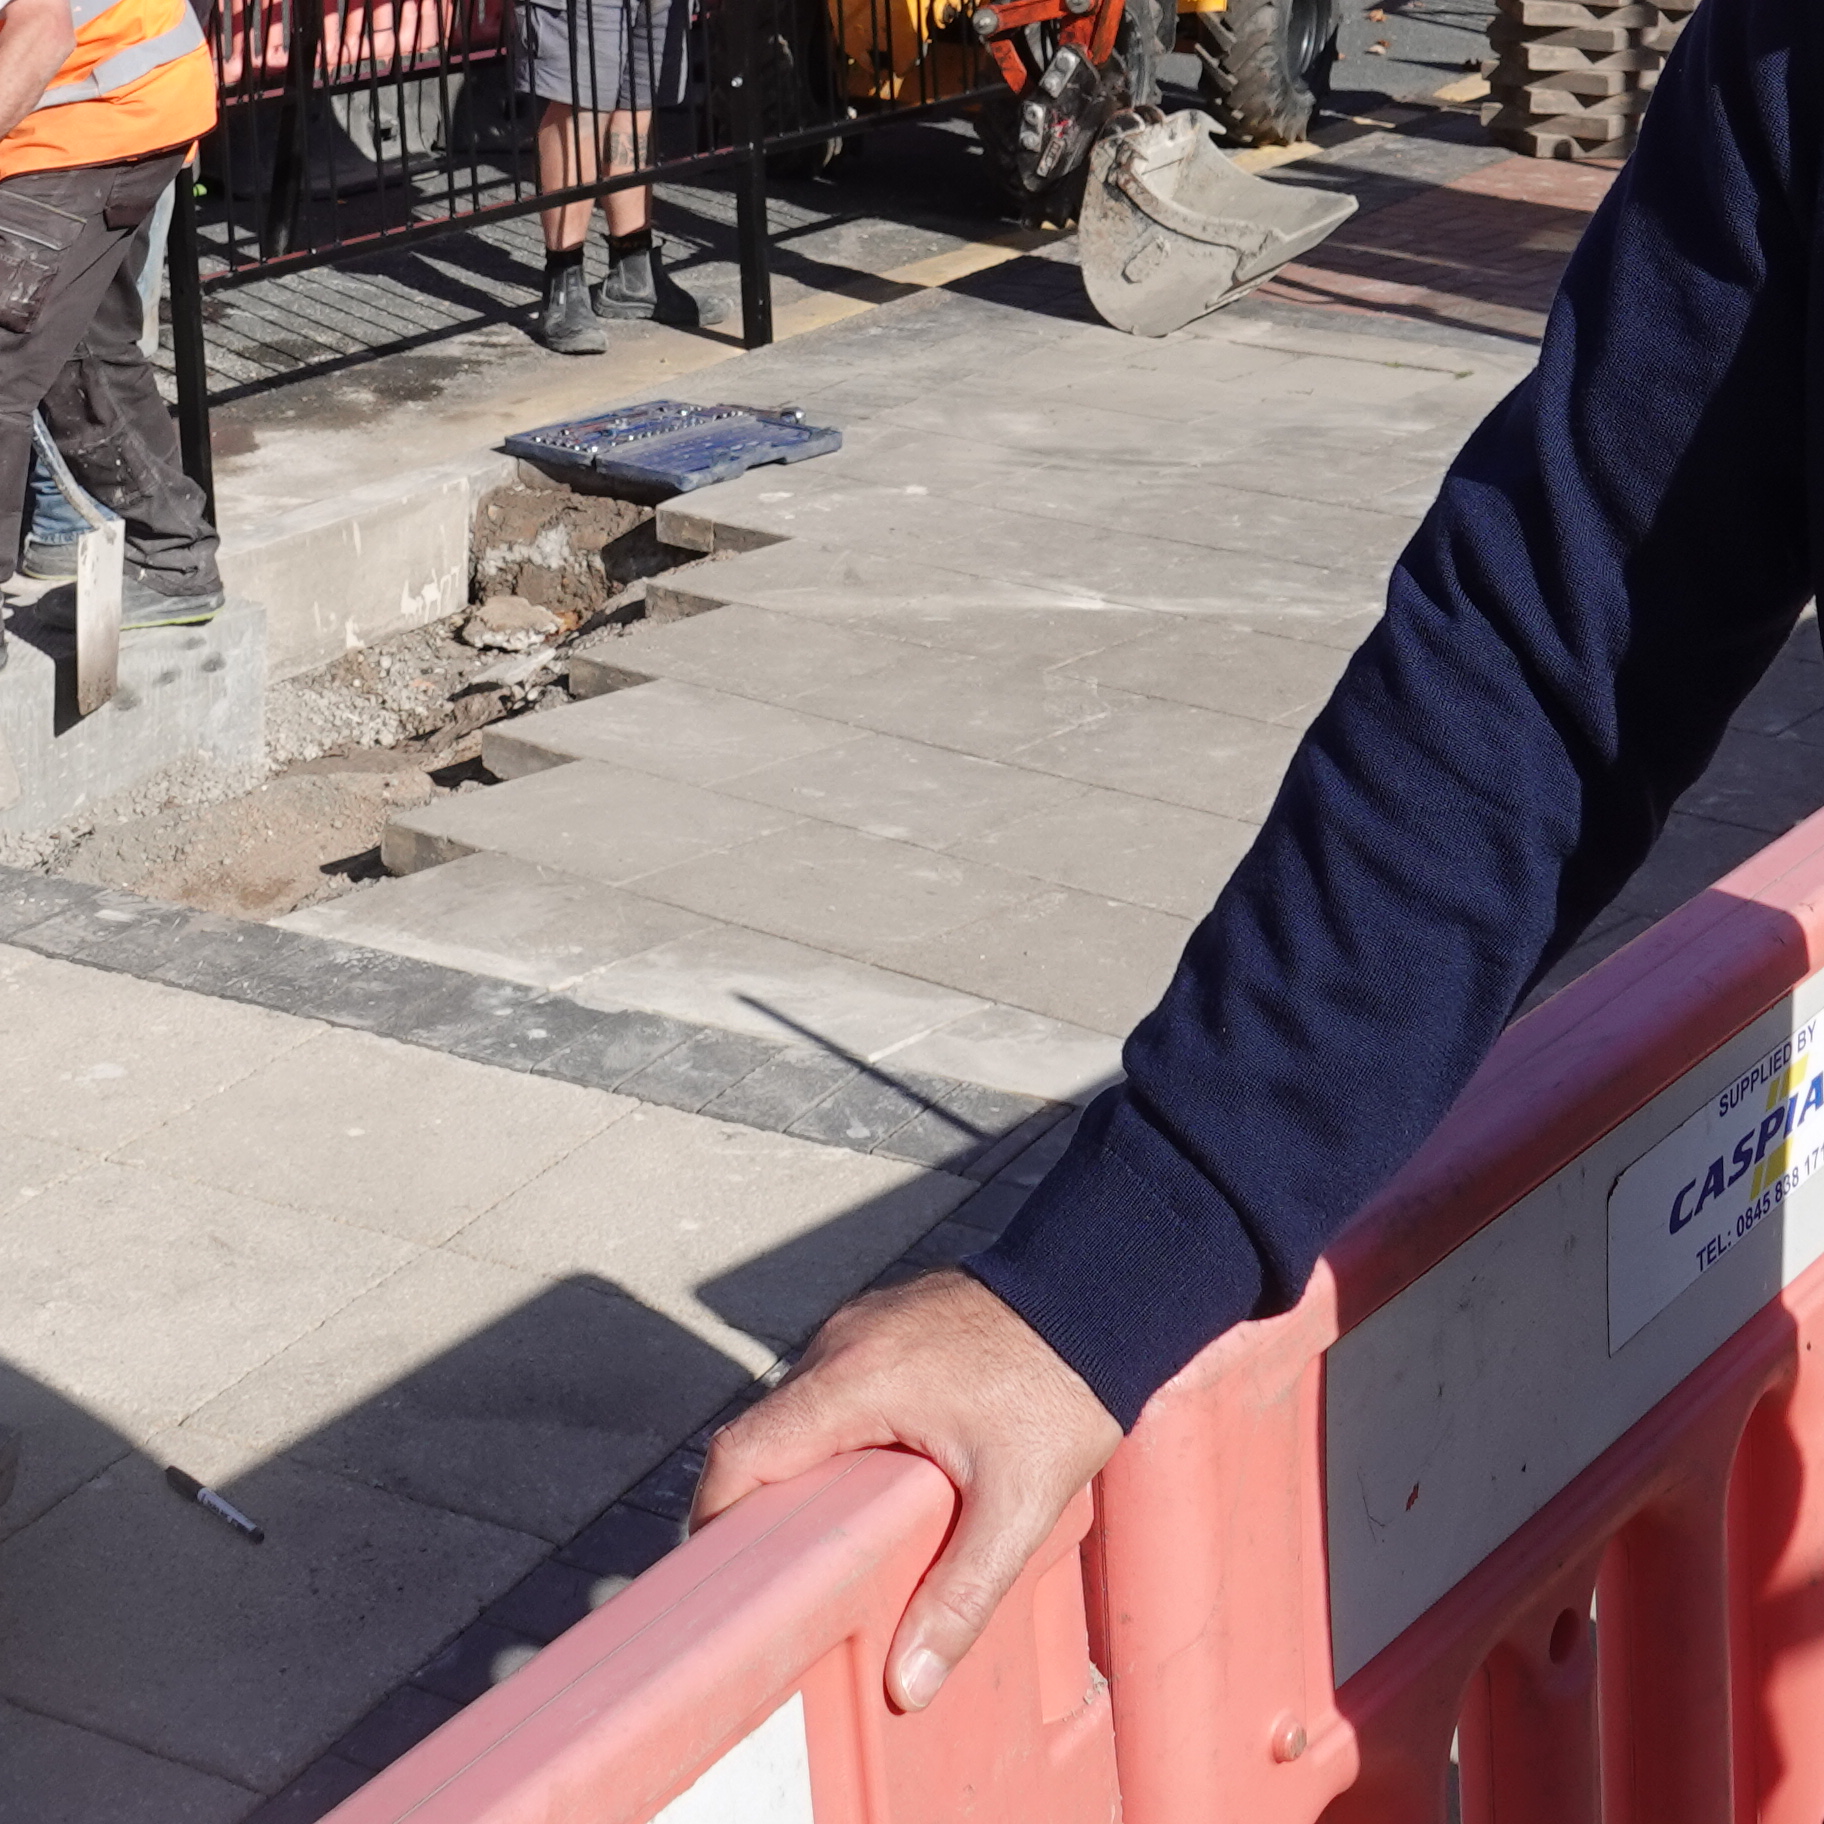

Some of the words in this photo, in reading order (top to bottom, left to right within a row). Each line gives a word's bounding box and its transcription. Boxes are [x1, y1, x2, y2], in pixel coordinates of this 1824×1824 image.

[1718, 1041, 1793, 1118] SUPPLIED
[1797, 1019, 1817, 1054] BY
[1695, 1230, 1732, 1272] TEL:
[1736, 1191, 1771, 1237] 0845
[1775, 1166, 1800, 1203] 838
